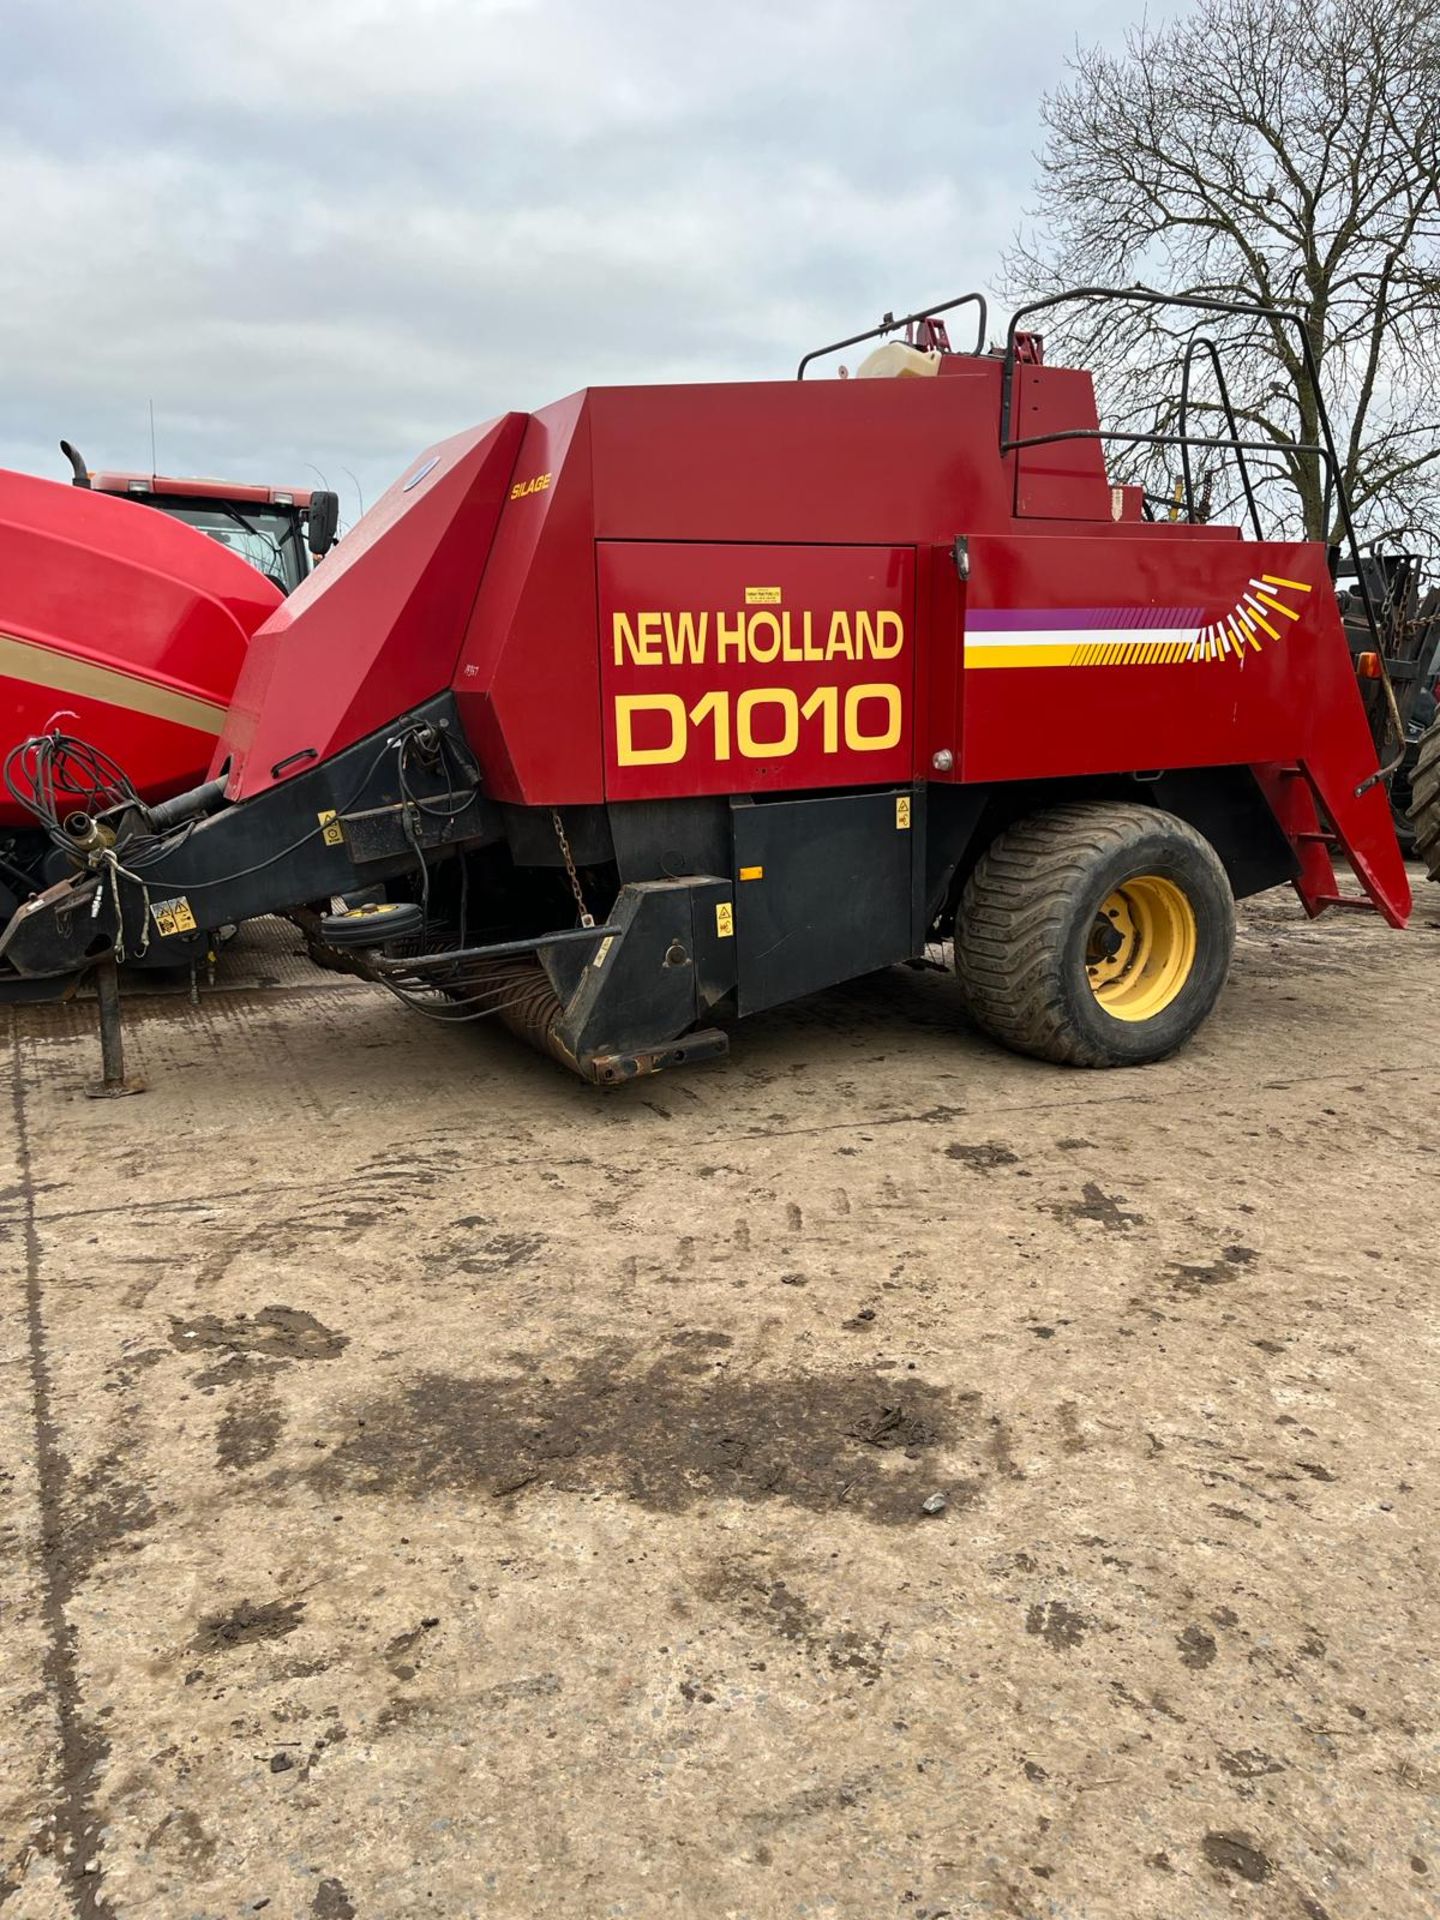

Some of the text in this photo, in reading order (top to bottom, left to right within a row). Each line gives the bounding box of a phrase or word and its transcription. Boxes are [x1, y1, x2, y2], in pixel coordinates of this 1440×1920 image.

[510, 473, 552, 500] SILAGE
[613, 610, 904, 666] NEW HOLLAND
[615, 683, 902, 766] D1010
